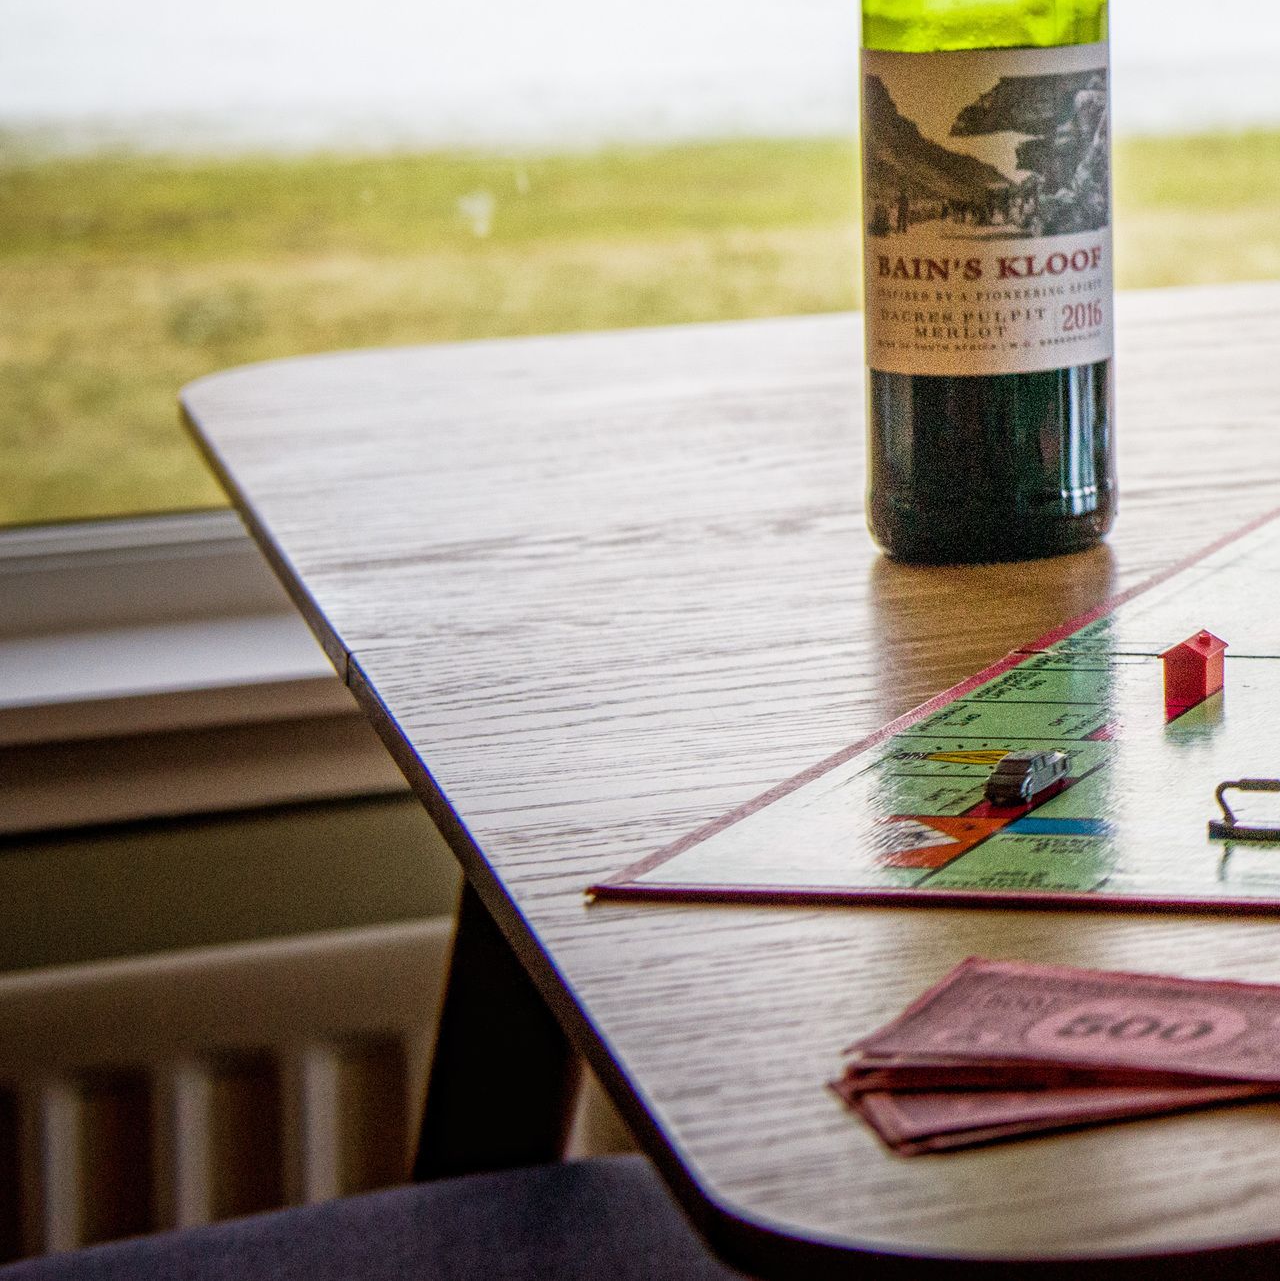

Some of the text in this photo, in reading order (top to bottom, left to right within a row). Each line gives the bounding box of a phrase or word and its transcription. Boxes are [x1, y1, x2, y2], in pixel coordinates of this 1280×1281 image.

[878, 246, 1102, 281] BAIN'S KLOOF
[935, 290, 952, 302] BY
[960, 290, 969, 301] A
[976, 285, 1064, 302] PIONEERING
[963, 307, 1047, 324] PULPIT
[1062, 299, 1103, 332] 2016
[914, 325, 1007, 339] MERLOT
[1056, 1011, 1215, 1043] 500
